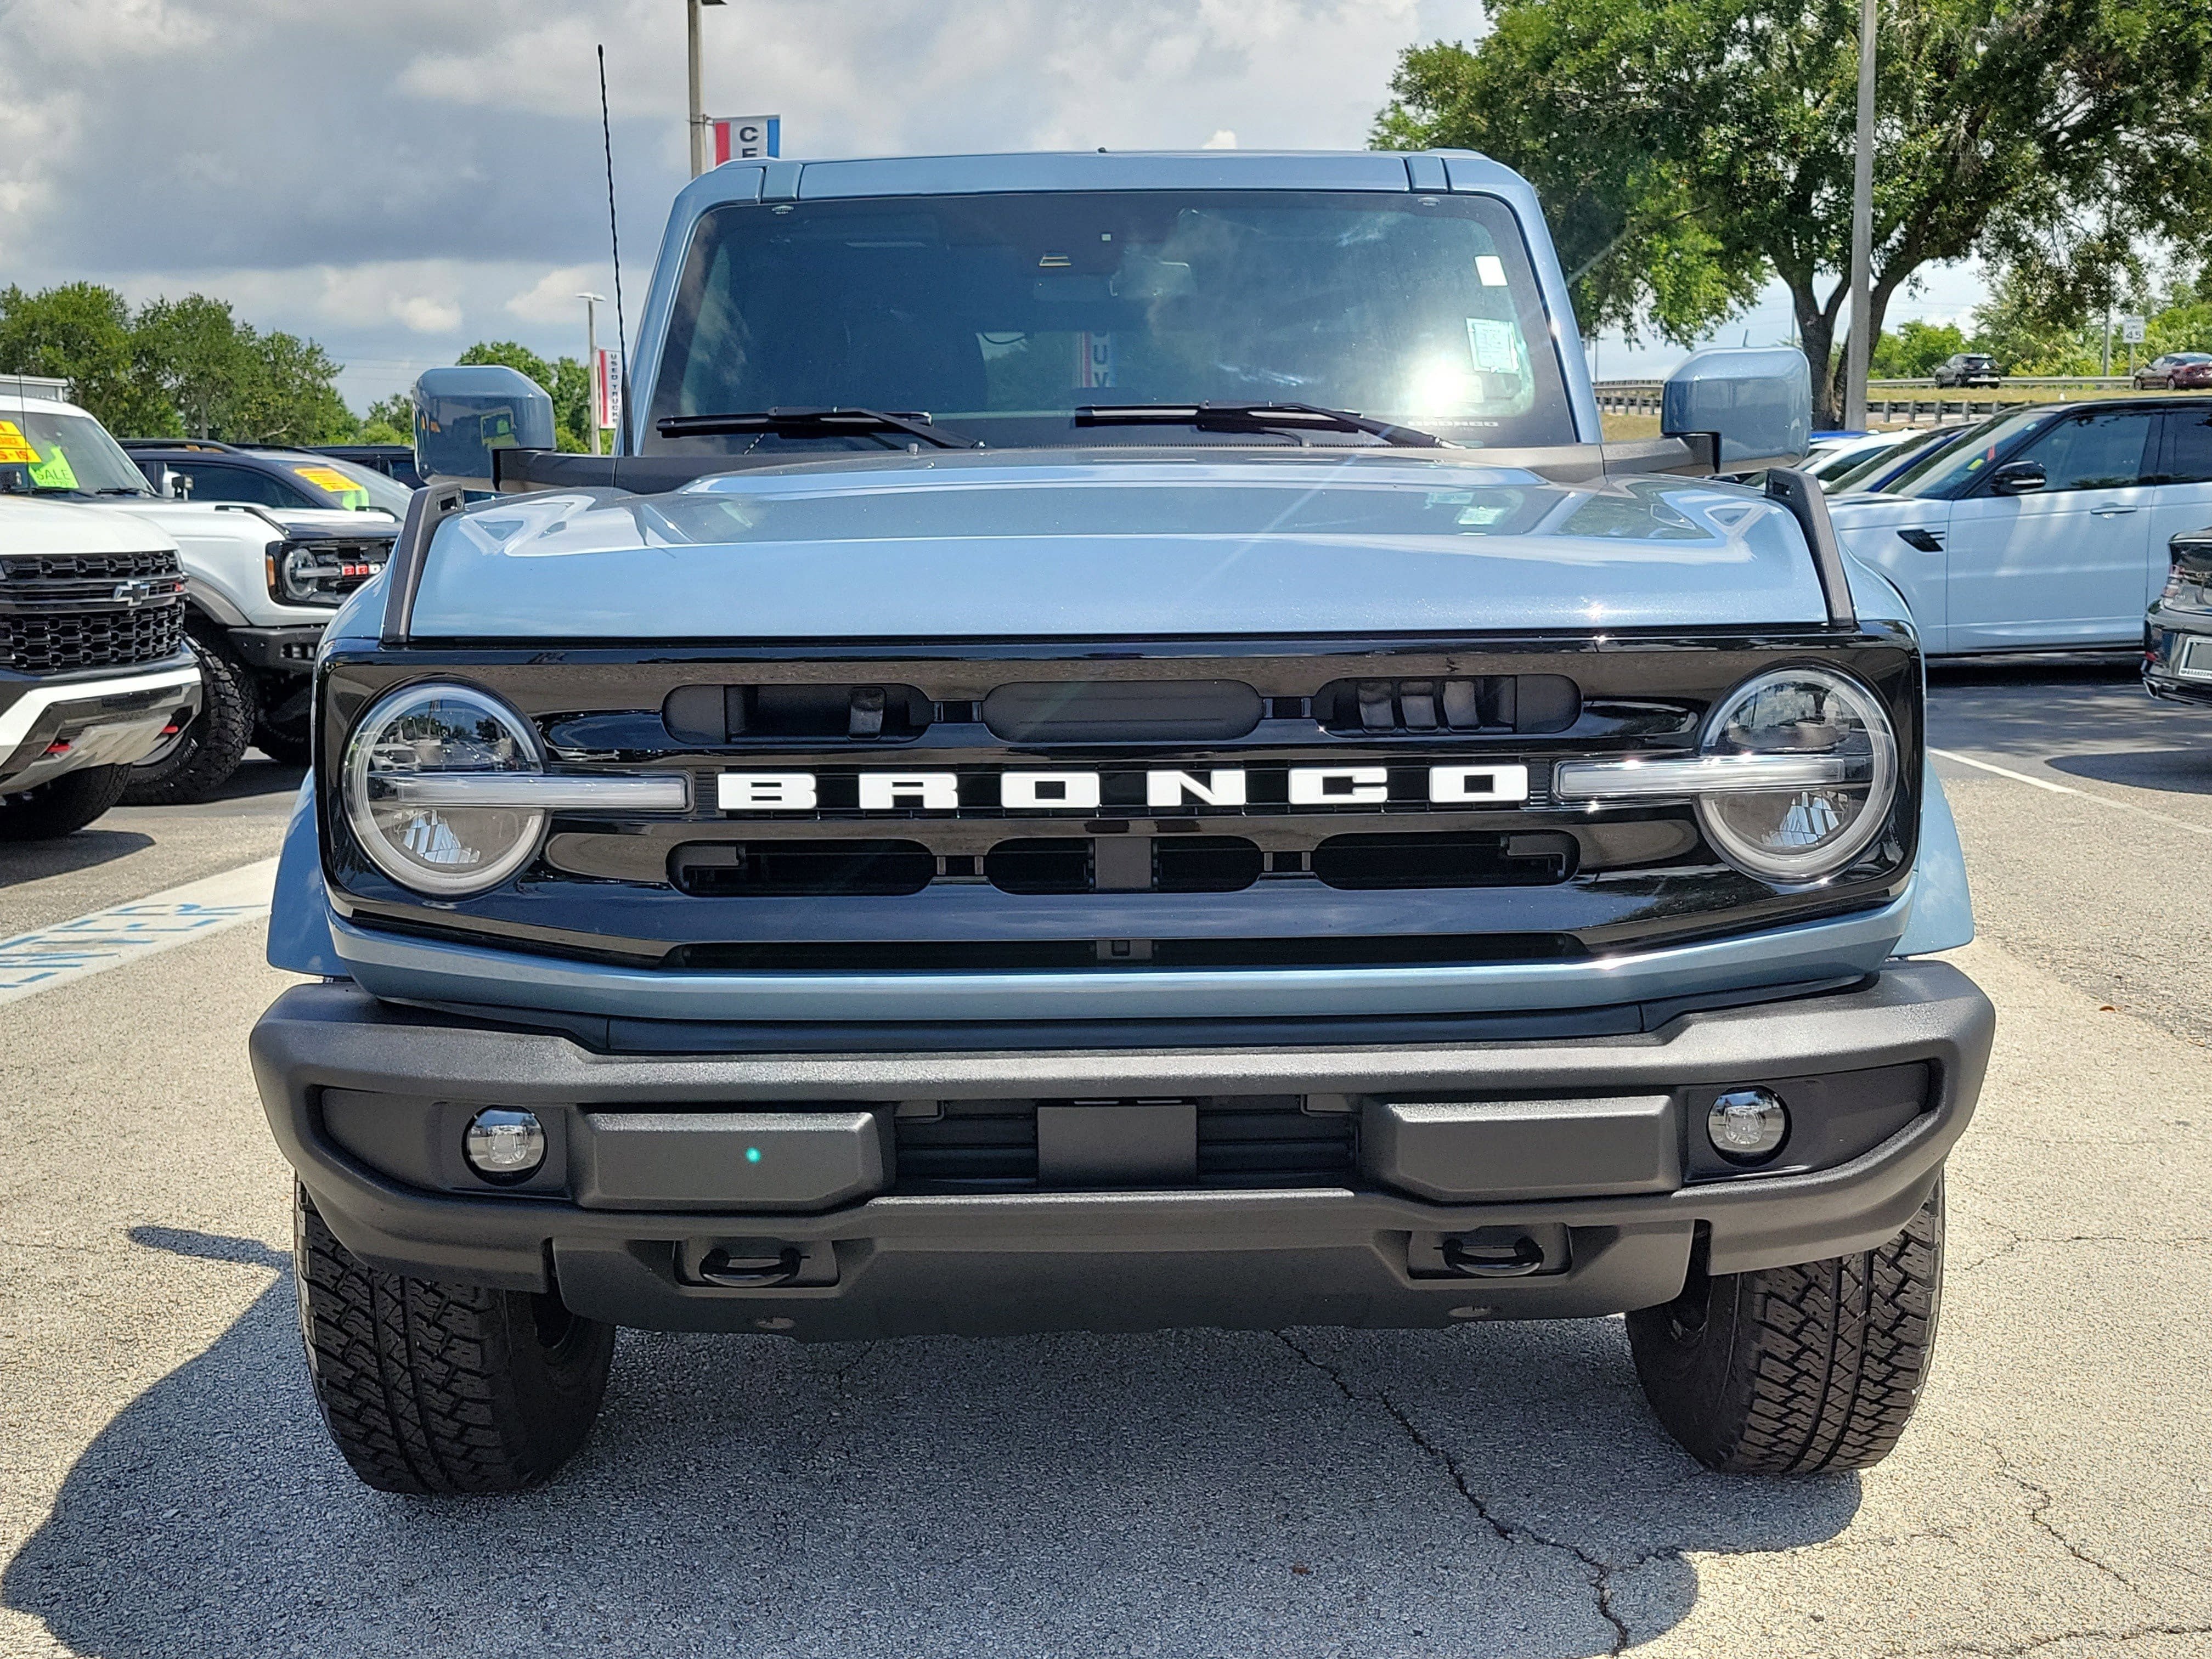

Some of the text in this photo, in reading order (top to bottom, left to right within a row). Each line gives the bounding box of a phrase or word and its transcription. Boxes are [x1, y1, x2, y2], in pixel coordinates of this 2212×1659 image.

[610, 353, 618, 381] USED
[36, 469, 71, 480] SALE
[341, 563, 385, 576] BRO
[717, 764, 1528, 809] BRONCO
